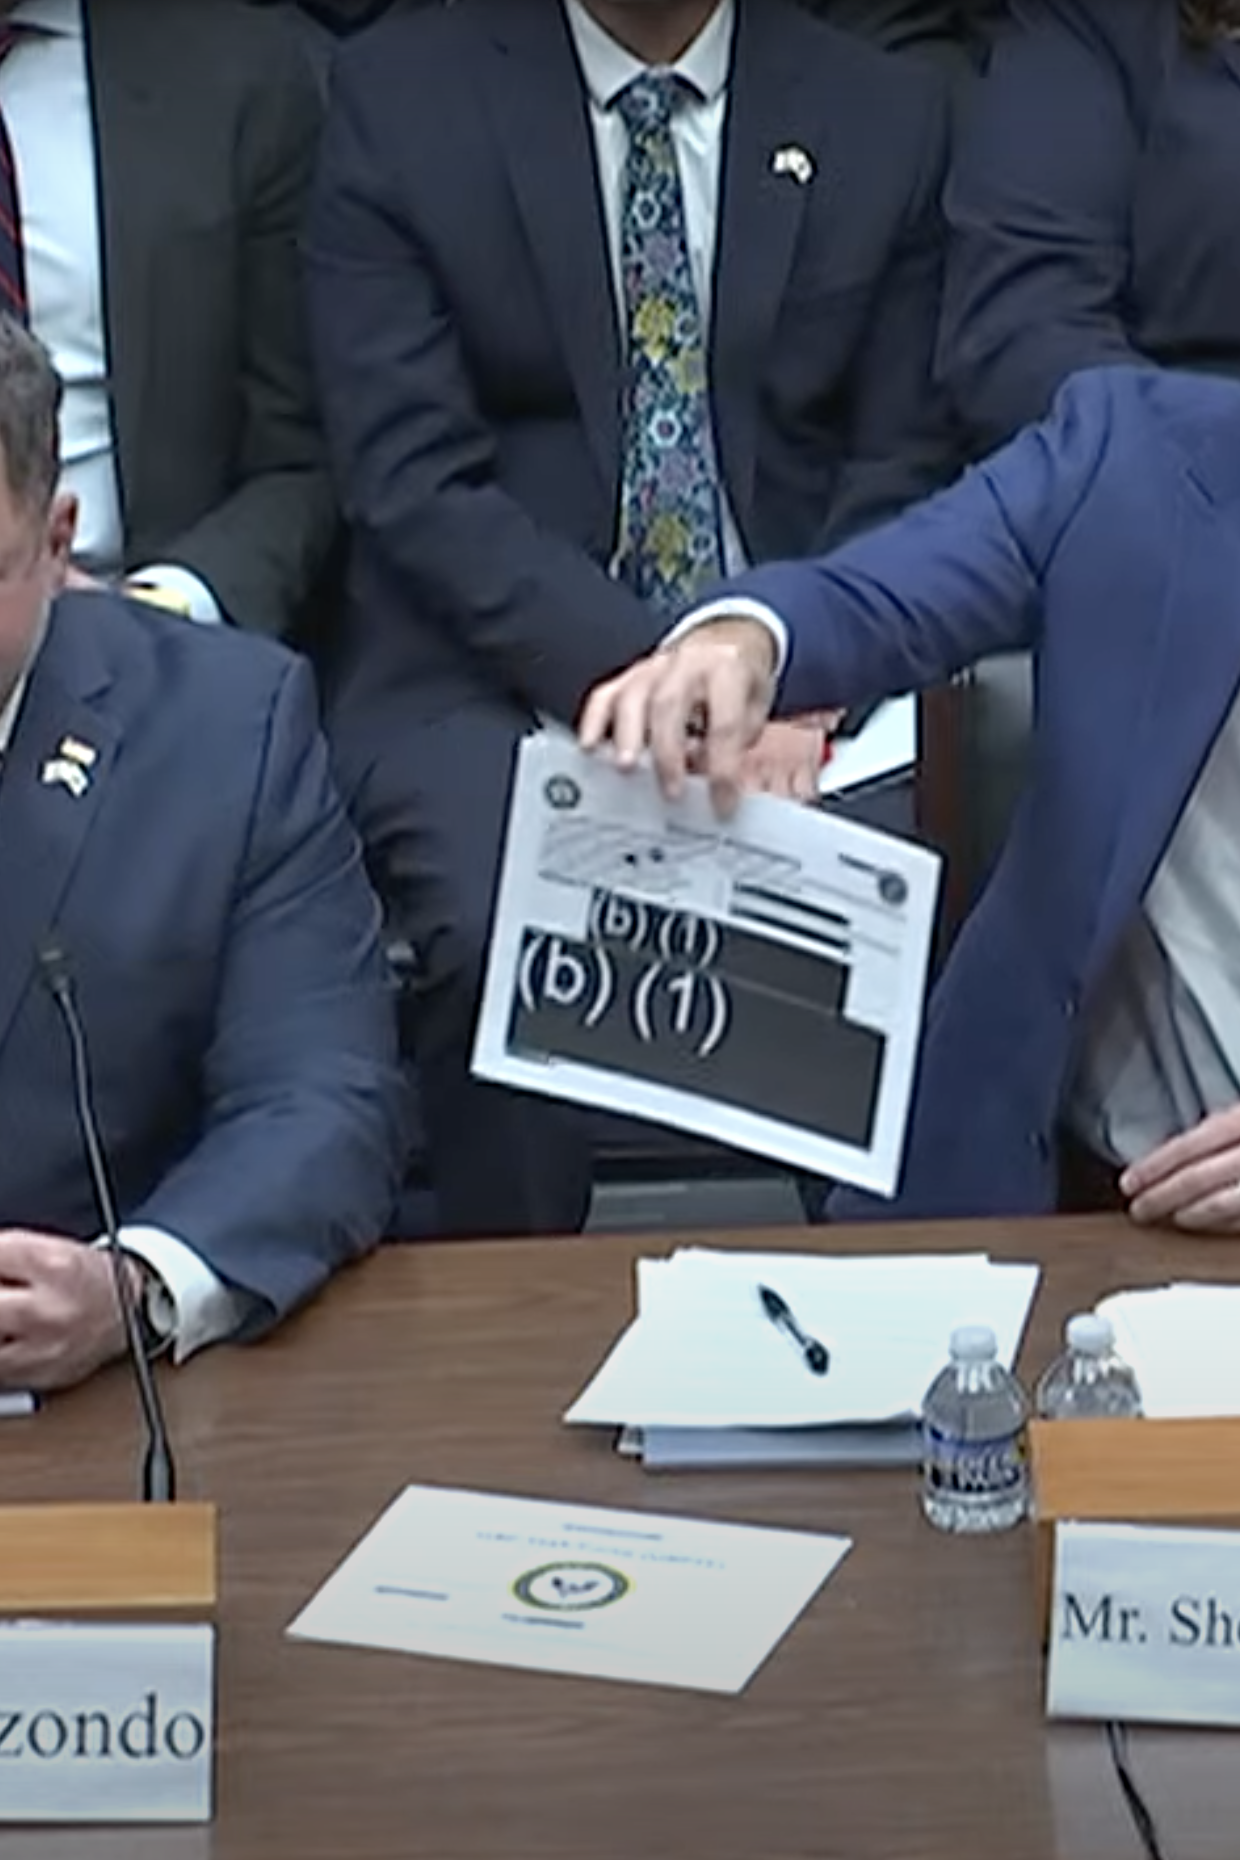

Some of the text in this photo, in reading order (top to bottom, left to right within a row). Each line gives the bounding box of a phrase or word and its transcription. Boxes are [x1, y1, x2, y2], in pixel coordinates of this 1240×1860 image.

[590, 889, 719, 969] (b) (1)
[519, 934, 728, 1058] (b) (1)
[1061, 1593, 1147, 1644] Mr.
[0, 1691, 206, 1760] zondo
